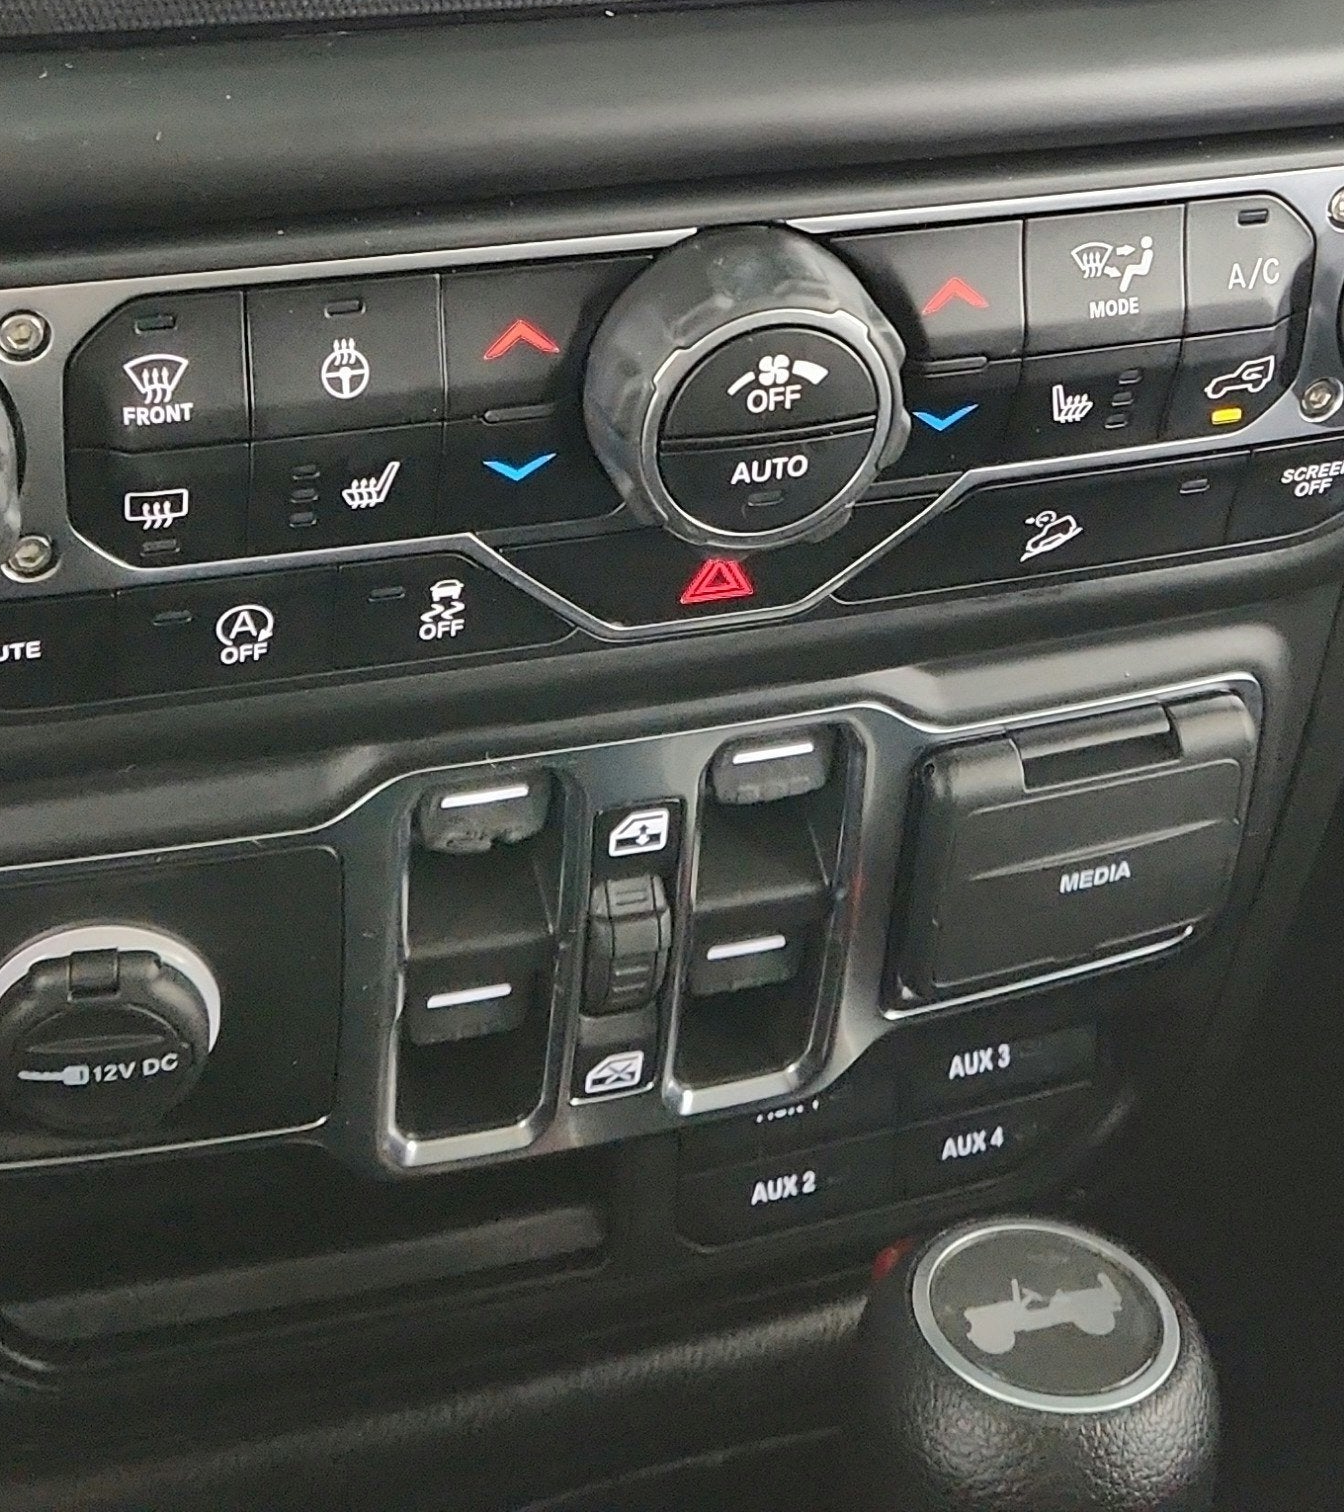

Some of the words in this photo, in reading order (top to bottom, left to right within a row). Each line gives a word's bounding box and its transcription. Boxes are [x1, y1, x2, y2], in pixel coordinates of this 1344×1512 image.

[1228, 257, 1280, 291] A/C
[1089, 296, 1140, 319] MODE
[122, 401, 195, 426] FRONT
[745, 383, 802, 414] OFF
[730, 454, 809, 485] AUTO
[1294, 476, 1333, 498] OFF
[418, 618, 466, 640] OFF
[220, 640, 269, 665] OFF
[1059, 860, 1132, 894] MEDIA
[93, 1061, 136, 1082] 12V
[142, 1052, 178, 1076] DC
[948, 1047, 994, 1080] AUX
[997, 1043, 1011, 1069] 3
[941, 1129, 987, 1161] AUX
[990, 1126, 1004, 1147] 4
[751, 1173, 798, 1206] AUX
[802, 1170, 816, 1194] 2
